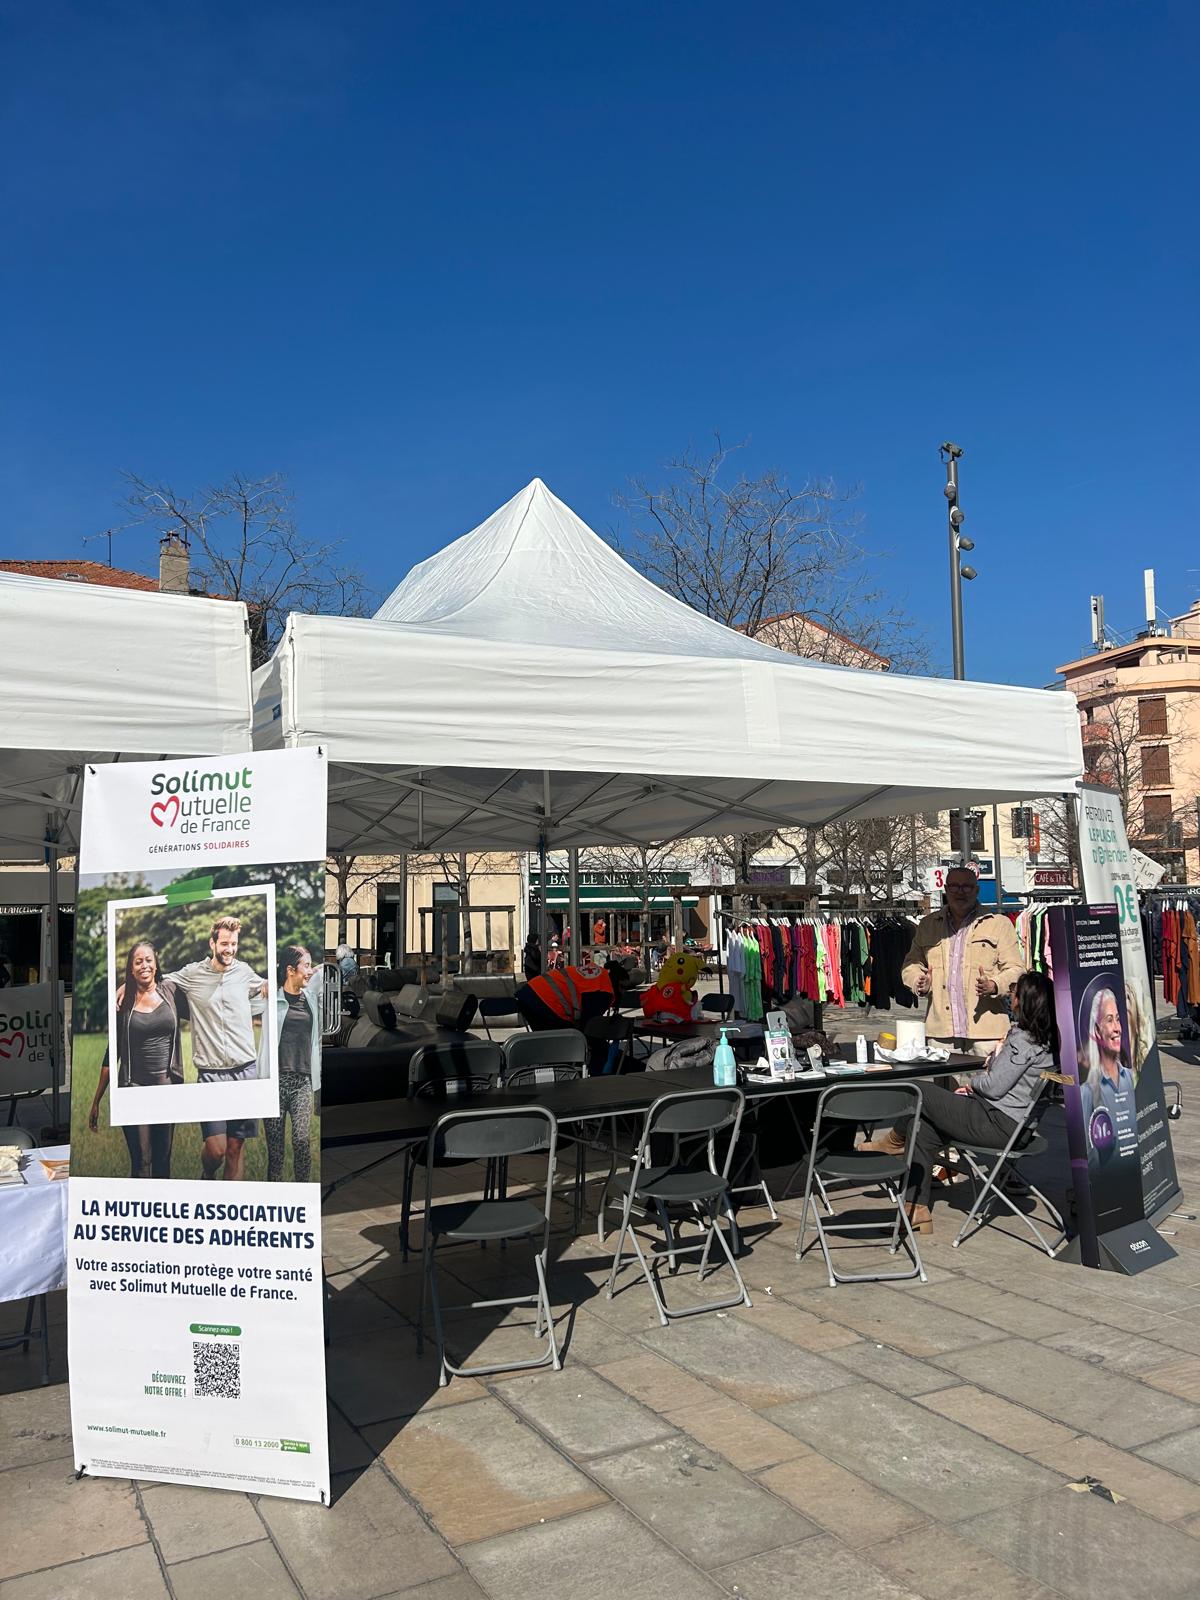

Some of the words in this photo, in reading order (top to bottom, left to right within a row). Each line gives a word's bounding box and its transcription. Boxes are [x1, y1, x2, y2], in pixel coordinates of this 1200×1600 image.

[151, 767, 252, 795] Solimut
[181, 820, 197, 834] de
[202, 817, 251, 833] France
[149, 842, 201, 854] GÉNÉRATIONS
[203, 839, 250, 851] SOLIDAIRES
[550, 874, 568, 885] BA
[582, 874, 598, 885] LE
[603, 874, 630, 885] NEW
[81, 1200, 100, 1216] LA
[105, 1200, 189, 1219] MUTUELLE
[194, 1203, 306, 1223] ASSOCIATIVE
[74, 1224, 96, 1240] AU
[101, 1225, 168, 1243] SERVICE
[173, 1228, 204, 1245] DES
[209, 1226, 314, 1249] ADHÉRENTS
[76, 1258, 107, 1271] Votre
[111, 1260, 180, 1275] association
[184, 1263, 234, 1280] protège
[238, 1266, 271, 1279] votre
[276, 1267, 313, 1282] santé
[89, 1279, 117, 1292] avec
[120, 1279, 167, 1294] Solimut
[171, 1282, 227, 1297] Mutuelle
[231, 1285, 246, 1298] de
[250, 1286, 298, 1301] France.
[152, 1370, 186, 1385] DÉCOUVREZ
[144, 1385, 164, 1395] NOTRE
[165, 1387, 183, 1397] OFFRE
[87, 1425, 167, 1438] www.solimut-mutuelle.fr
[241, 1439, 253, 1447] 800
